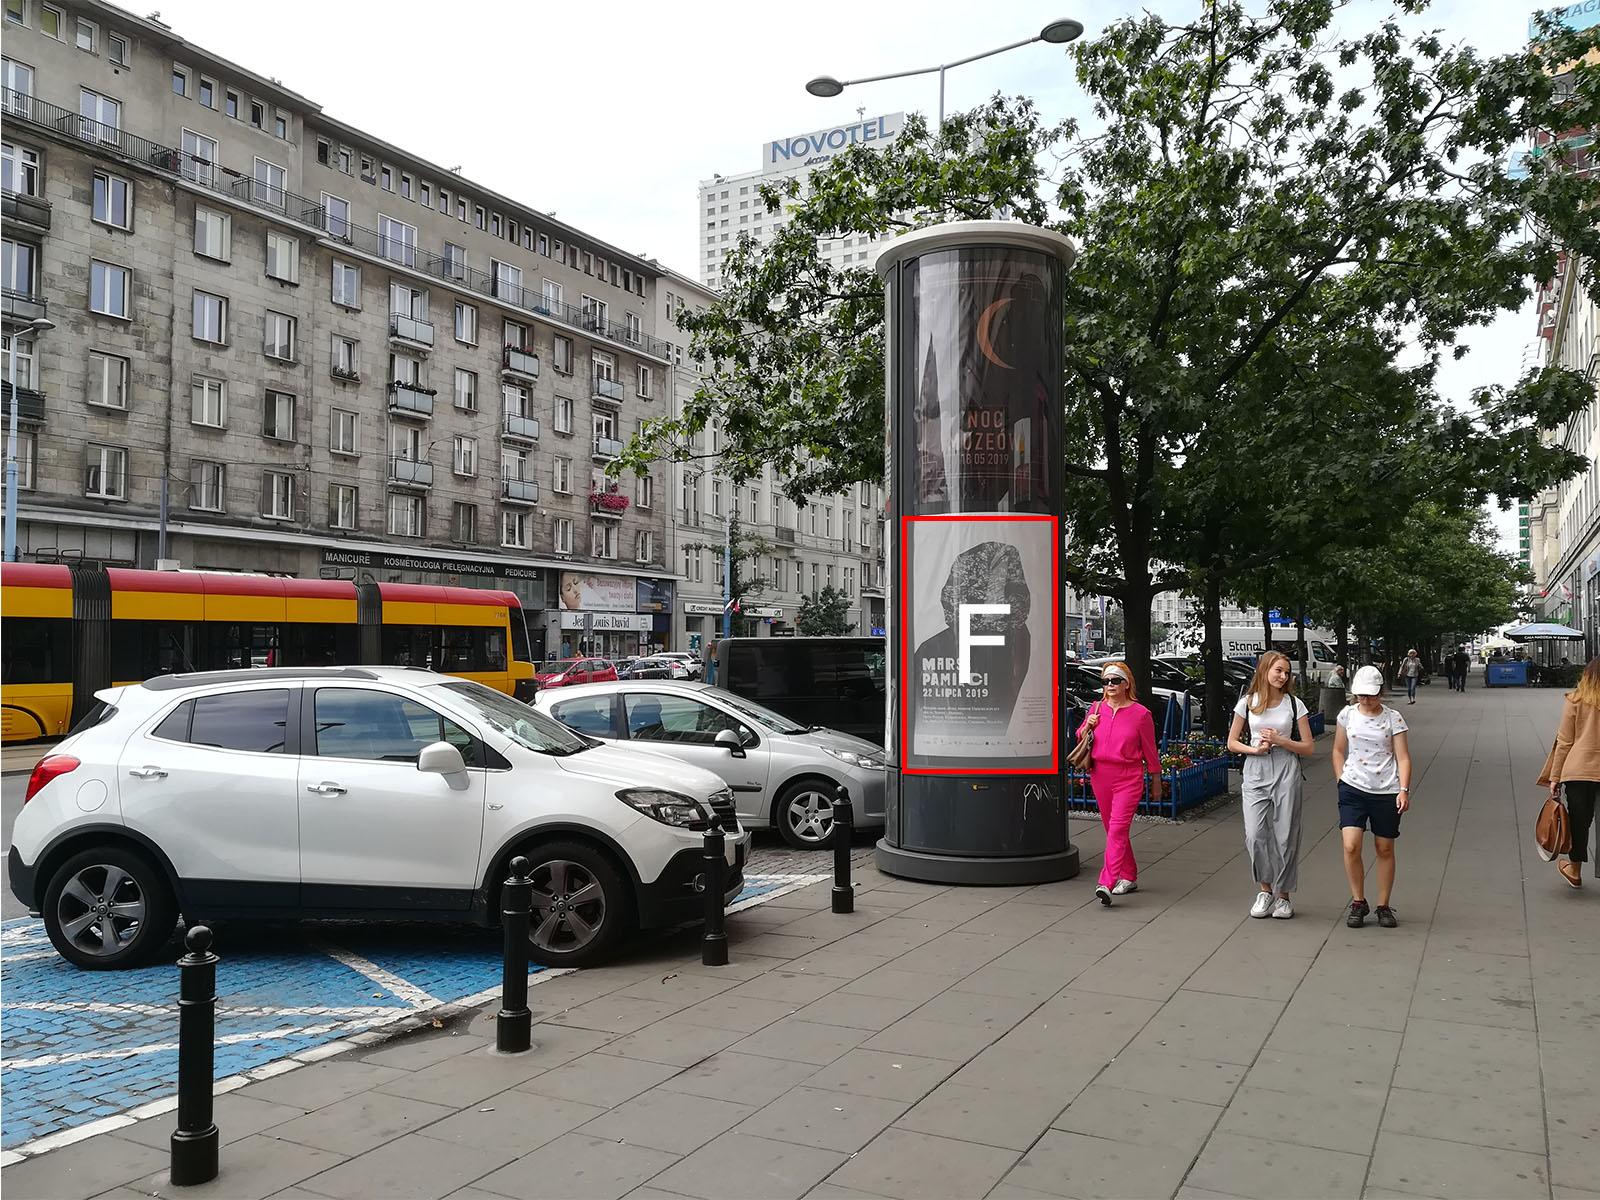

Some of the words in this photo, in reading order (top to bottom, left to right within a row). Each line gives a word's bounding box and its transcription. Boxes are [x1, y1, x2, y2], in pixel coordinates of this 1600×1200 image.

[771, 116, 895, 163] NOVOTEL
[968, 410, 1003, 428] NOC
[325, 552, 371, 564] MANICURE
[383, 557, 441, 570] KOSMETOLOGIA
[442, 562, 495, 574] PIELĘGNACYJNA
[505, 568, 537, 578] PEDICURE
[573, 615, 584, 627] Jea
[611, 616, 630, 628] David
[922, 672, 988, 687] PAMICI
[922, 688, 933, 697] 22
[935, 688, 962, 697] LIPCA
[966, 688, 989, 698] 2019
